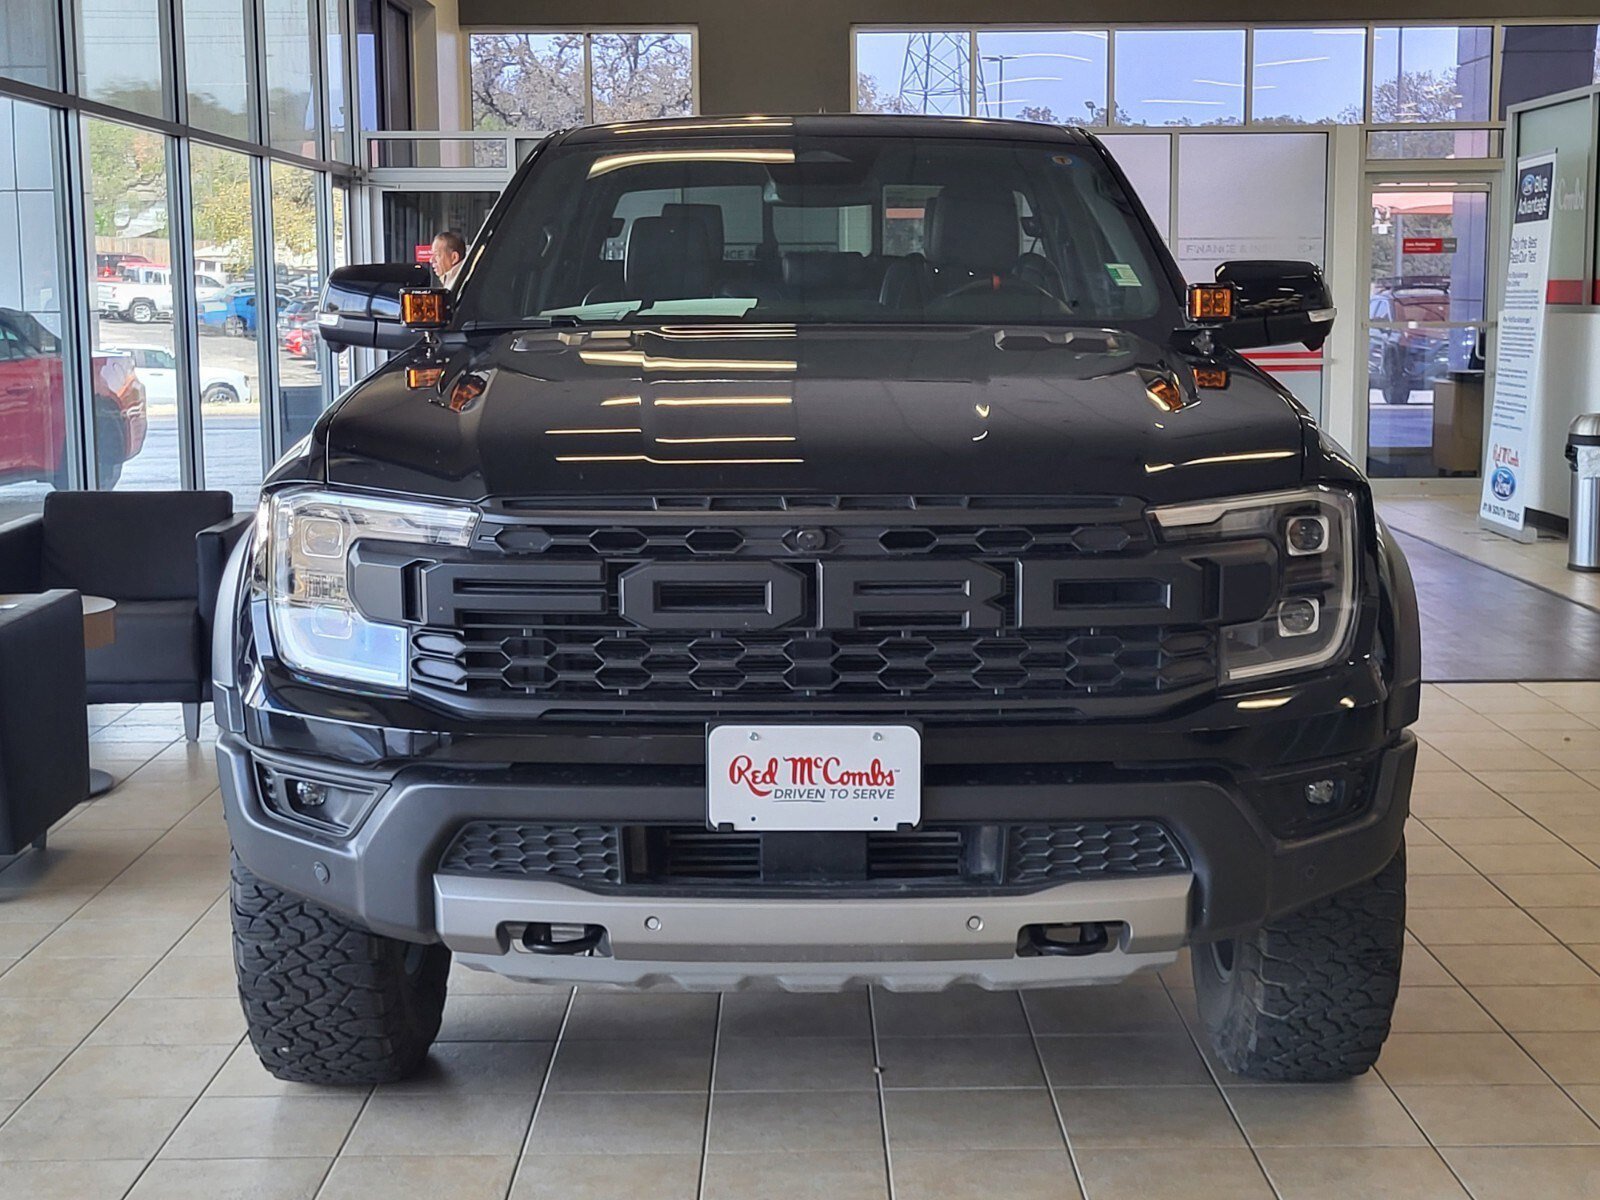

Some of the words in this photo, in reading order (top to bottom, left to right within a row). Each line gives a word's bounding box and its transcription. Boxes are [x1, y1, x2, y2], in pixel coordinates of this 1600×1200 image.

[1535, 175, 1549, 193] Blue
[1518, 195, 1549, 215] Advantage
[1495, 472, 1511, 496] Ford
[420, 558, 1206, 628] FORD
[729, 755, 778, 797] Red
[783, 756, 895, 787] McCombs
[774, 788, 825, 800] DRIVEN
[830, 788, 849, 800] TO
[852, 788, 896, 800] SERVE
